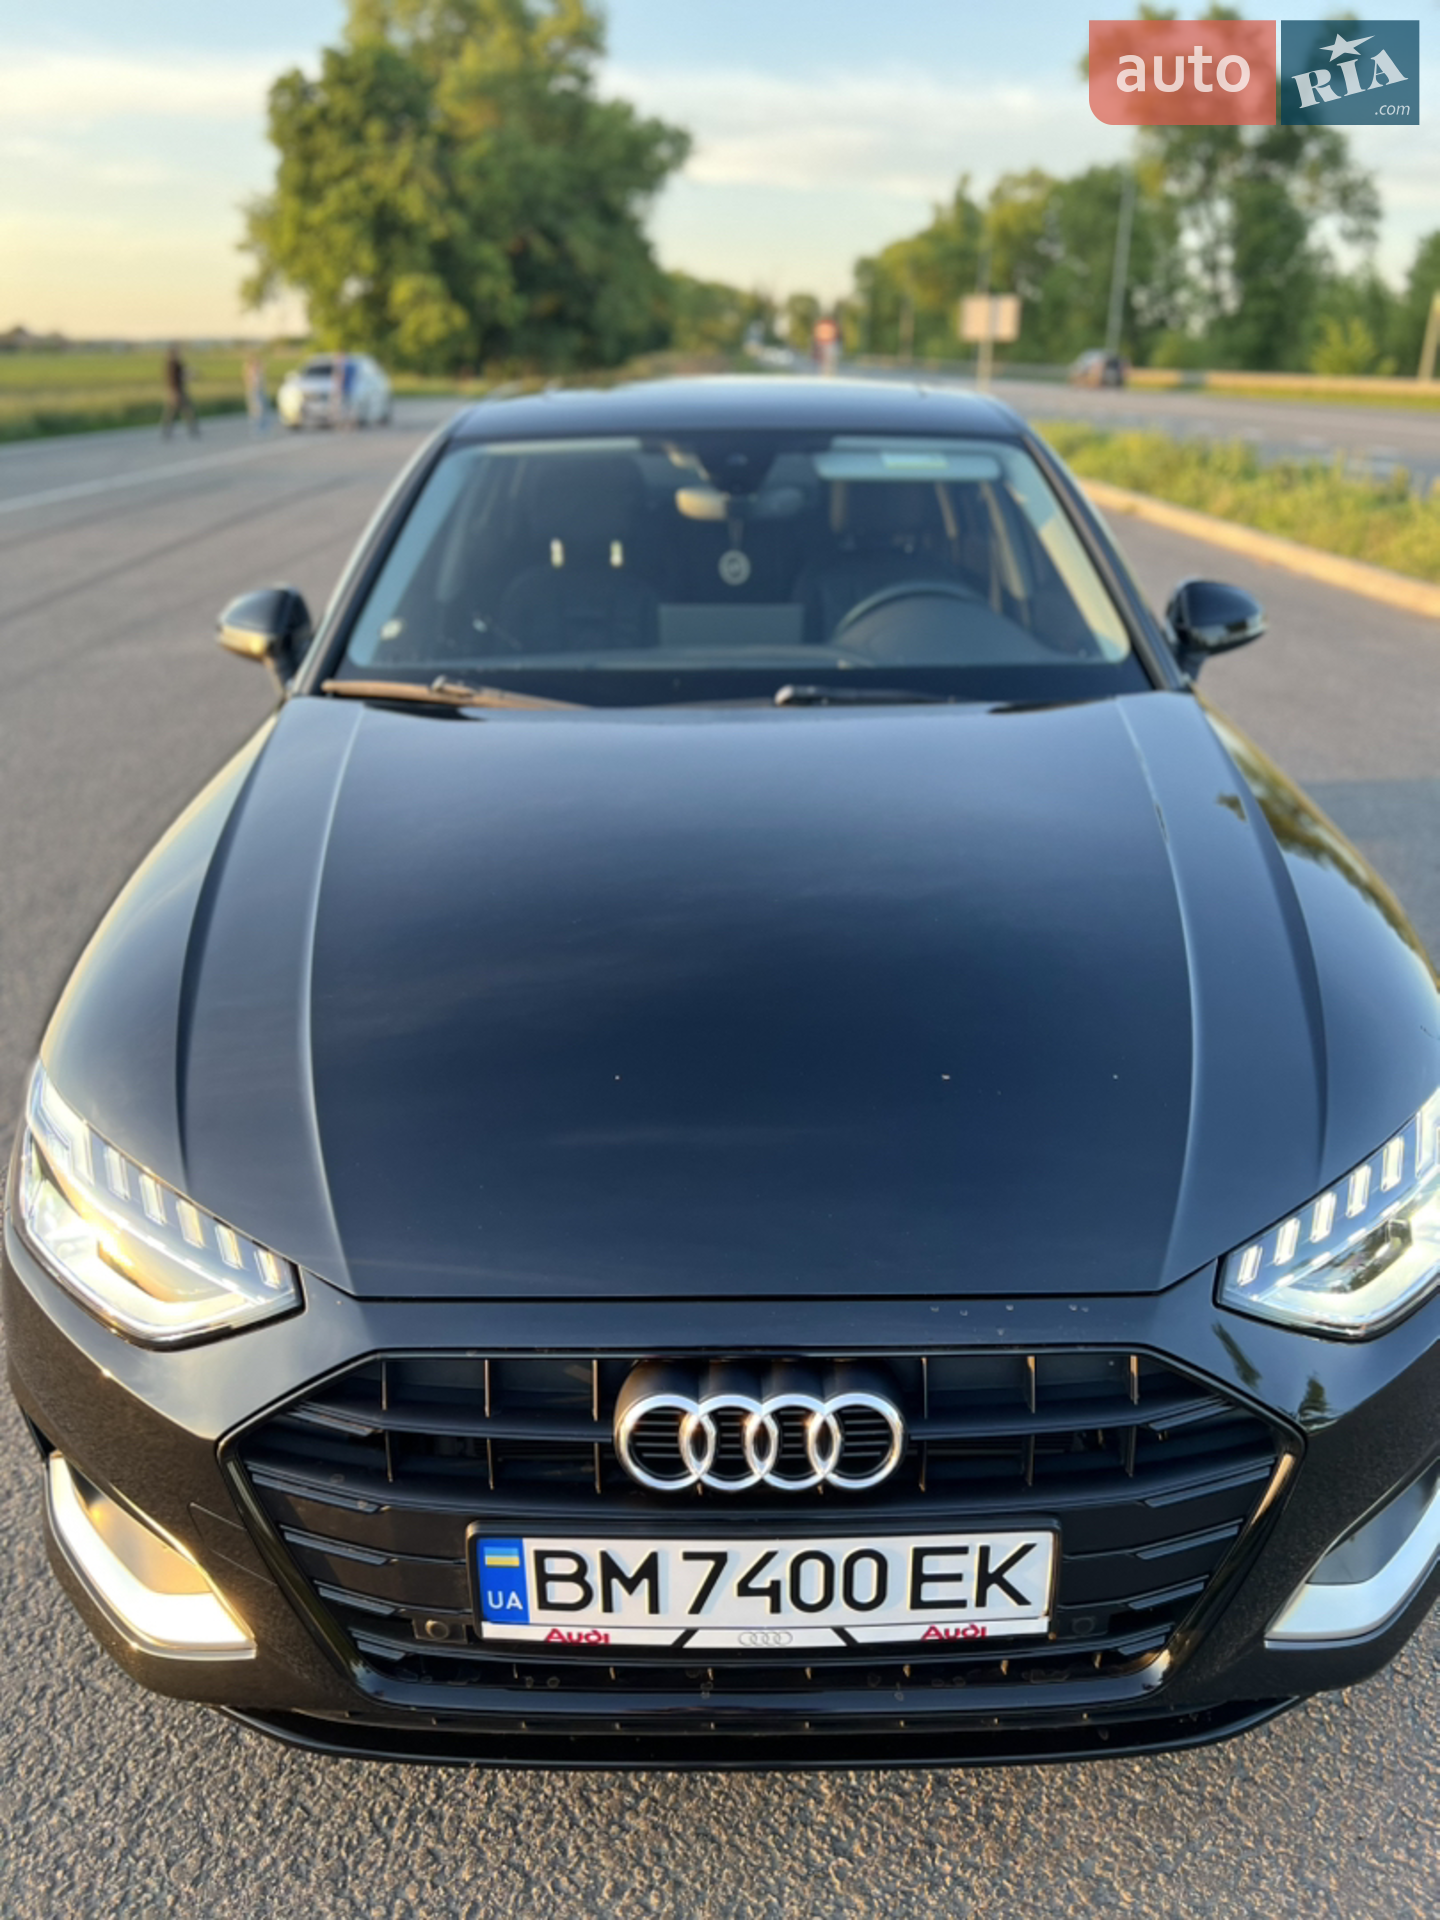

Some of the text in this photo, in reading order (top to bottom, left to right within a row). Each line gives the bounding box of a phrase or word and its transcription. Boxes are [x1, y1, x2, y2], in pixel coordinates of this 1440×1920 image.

[534, 1543, 1038, 1614] BM 7400 EK
[487, 1591, 523, 1610] UA
[545, 1628, 611, 1646] Audi
[921, 1624, 987, 1641] Audi
